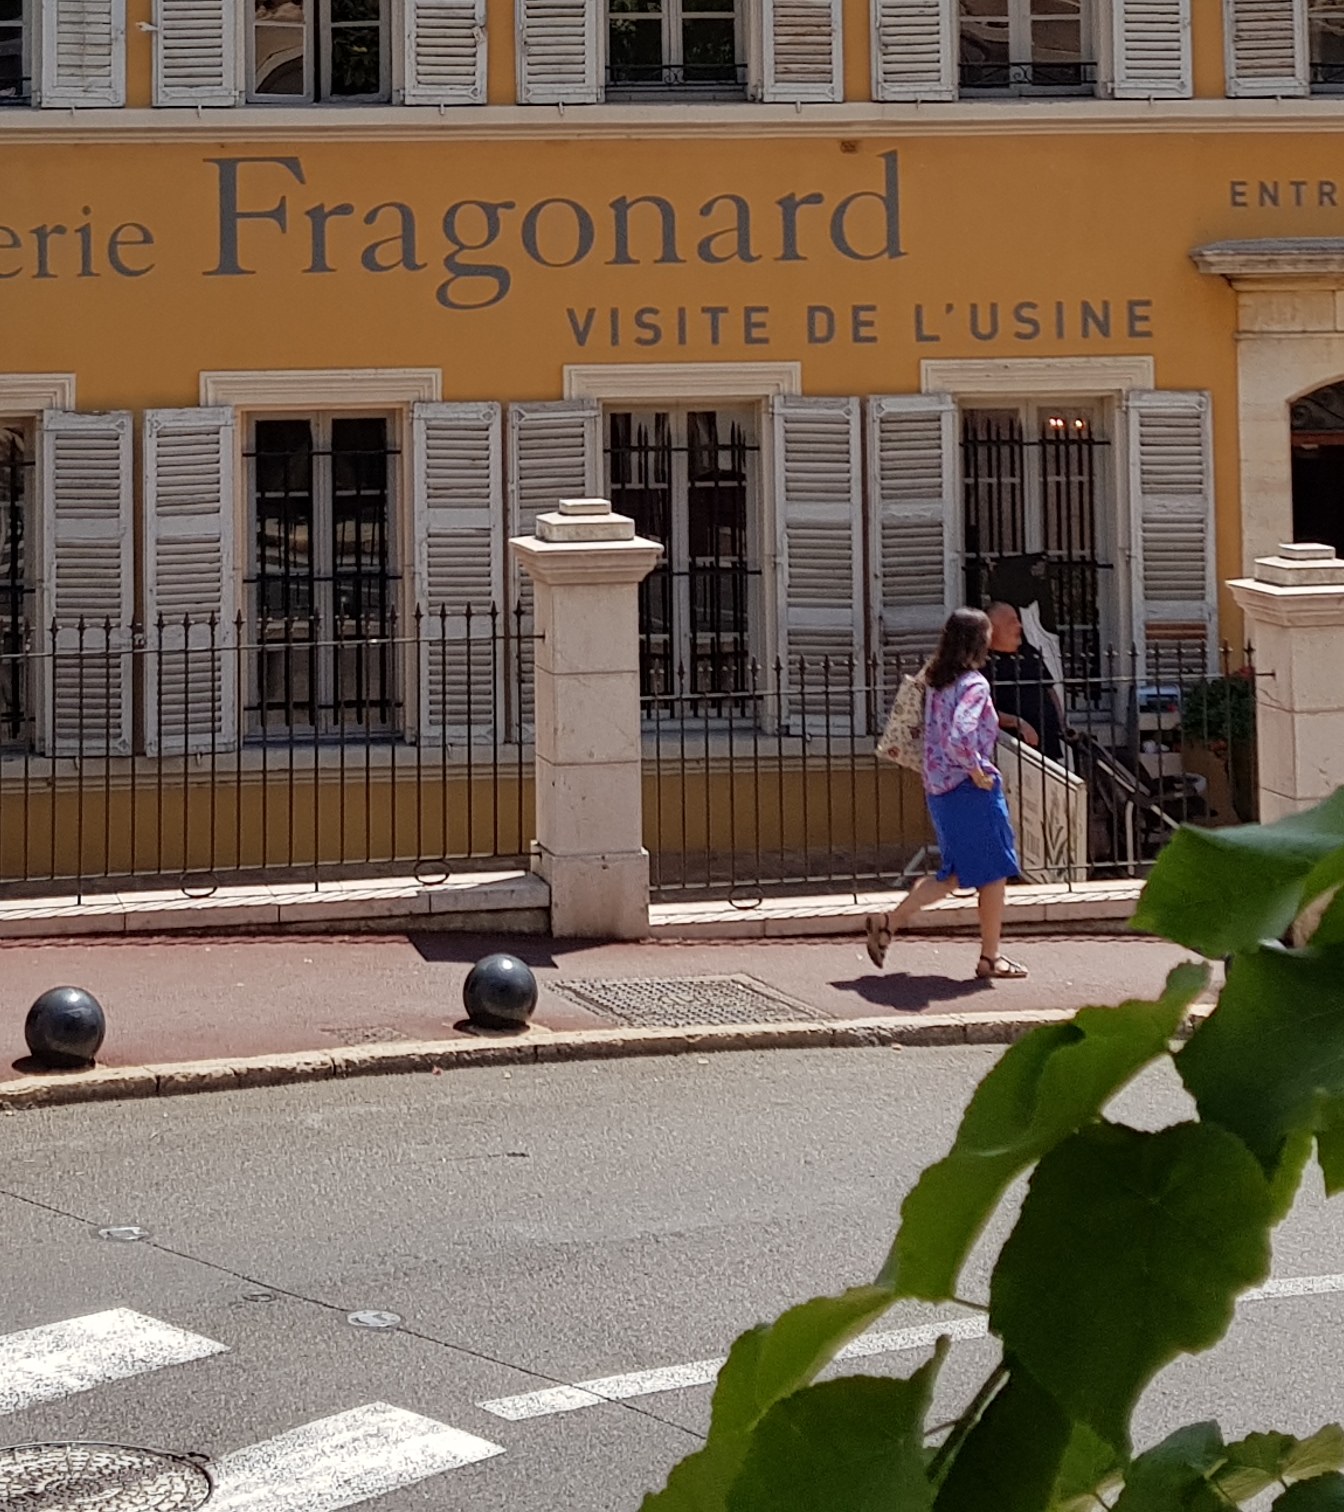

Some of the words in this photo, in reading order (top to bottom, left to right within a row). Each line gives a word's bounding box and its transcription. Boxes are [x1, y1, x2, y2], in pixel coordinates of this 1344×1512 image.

[201, 149, 908, 310] Fragonard
[566, 304, 770, 347] VISITE
[807, 303, 878, 344] DE
[915, 300, 1153, 343] L'USINE
